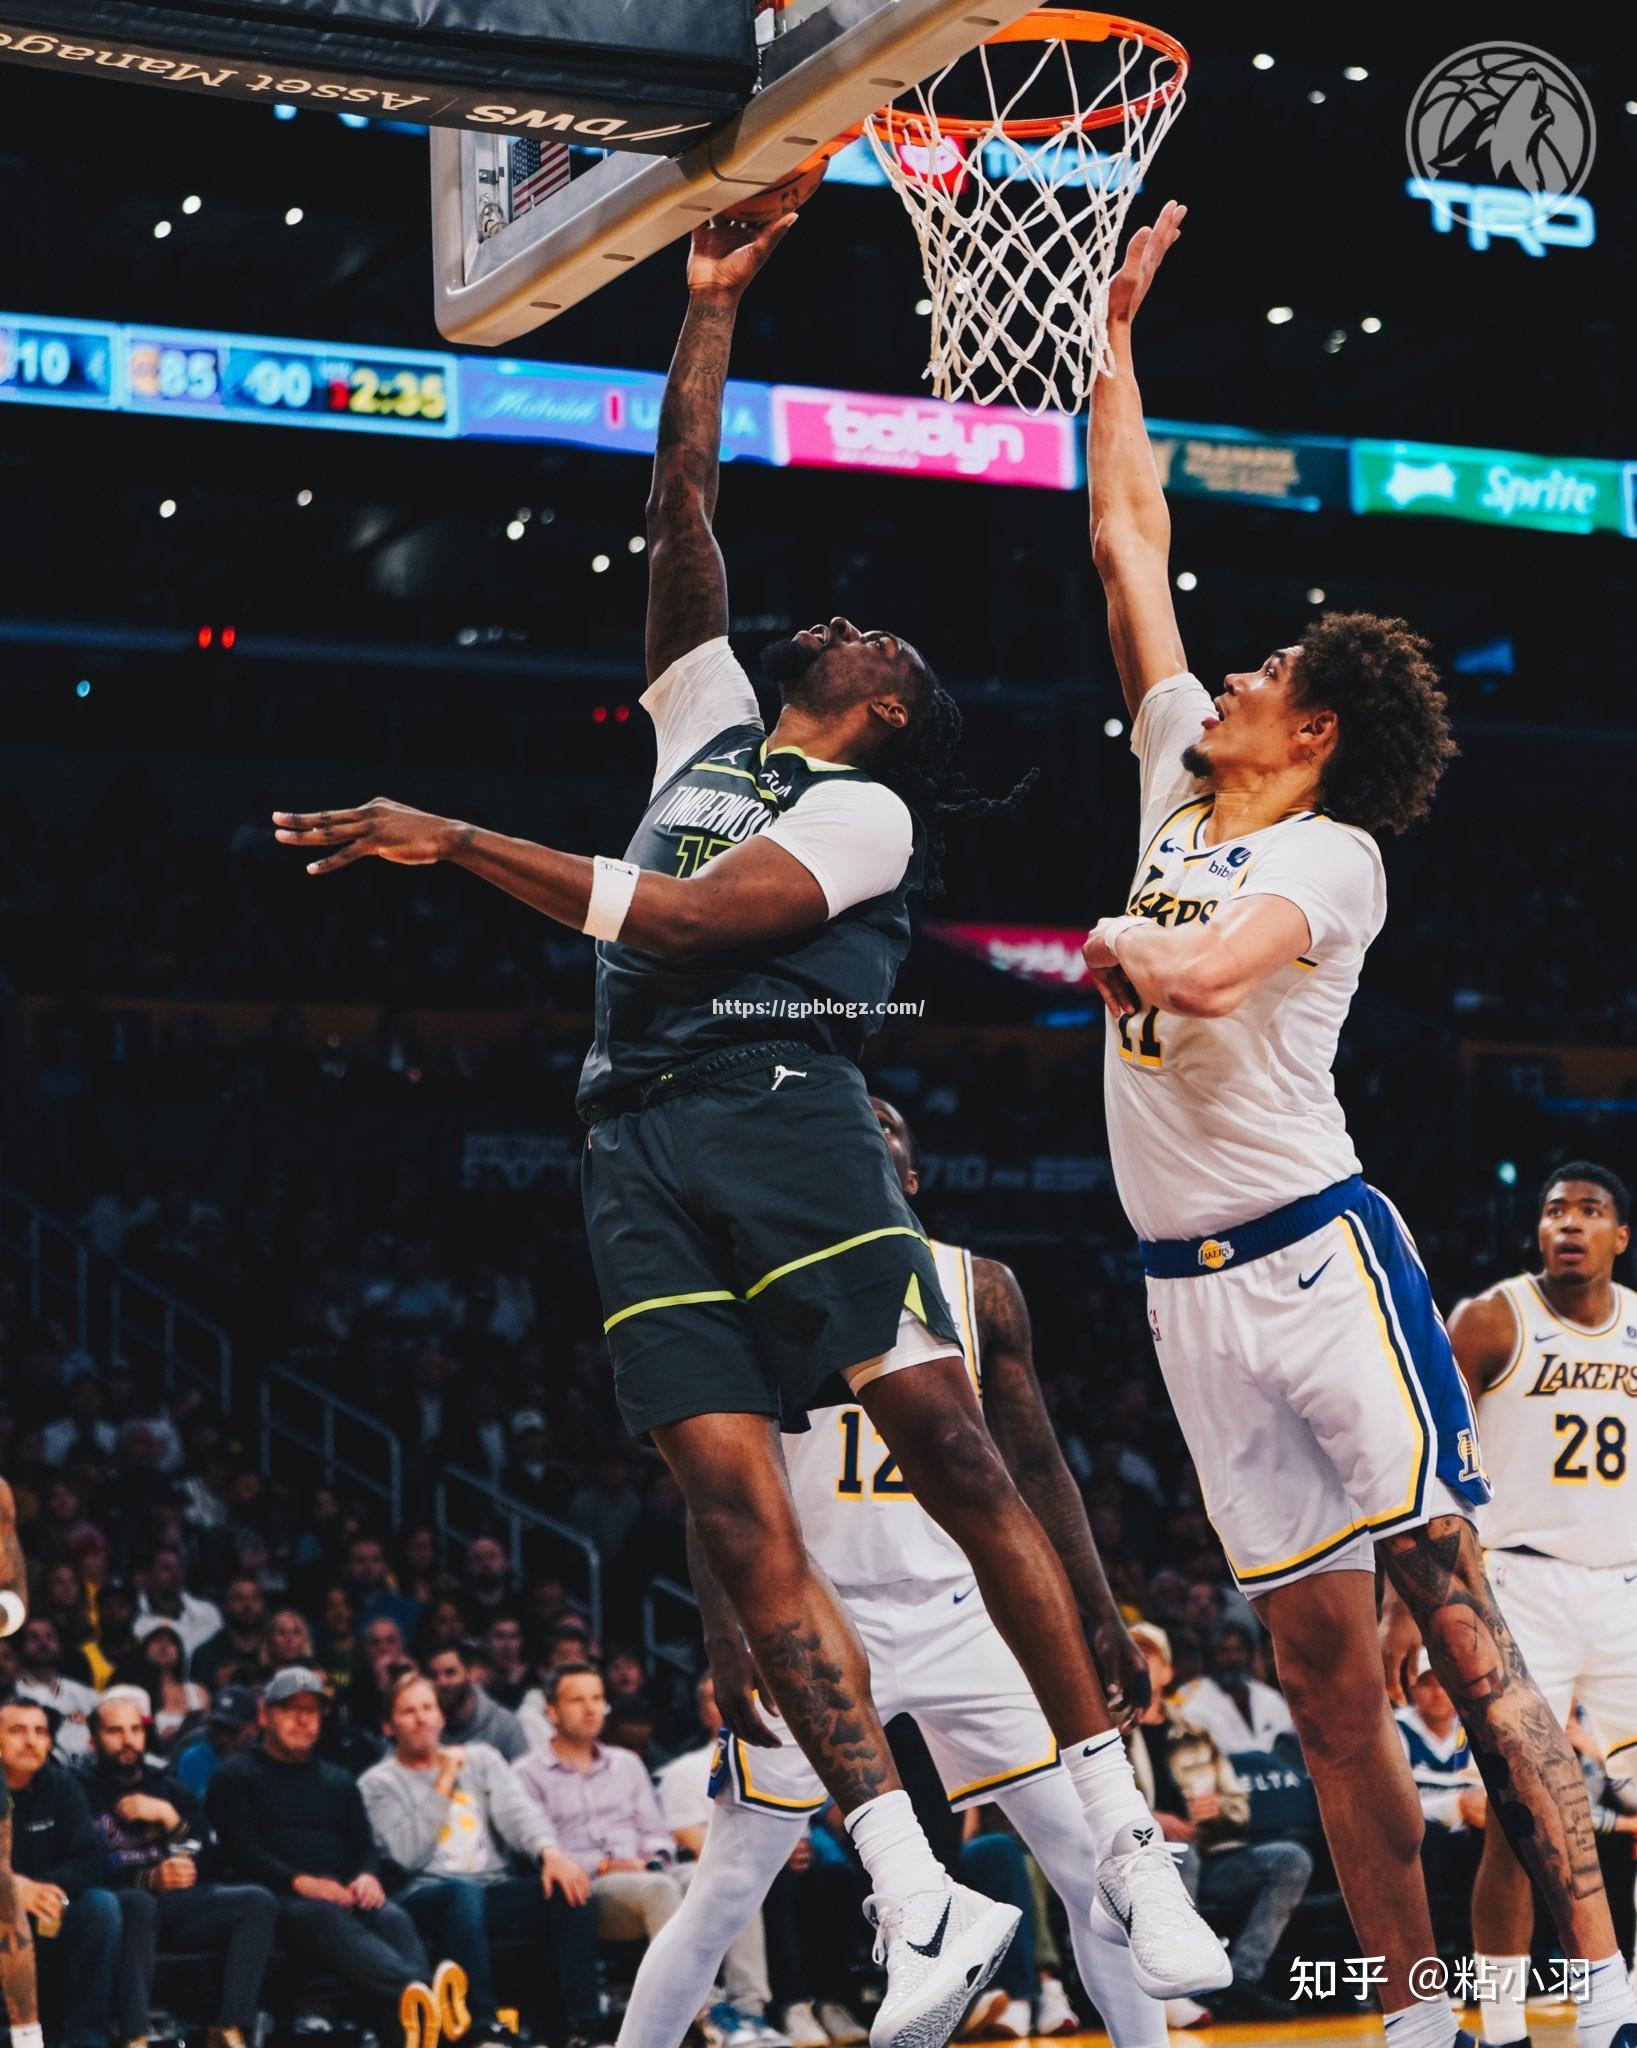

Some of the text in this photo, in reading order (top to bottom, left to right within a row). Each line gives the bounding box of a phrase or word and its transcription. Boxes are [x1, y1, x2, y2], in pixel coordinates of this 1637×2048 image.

[246, 74, 430, 111] Asset
[465, 104, 628, 137] DWS
[1405, 178, 1597, 257] TRD
[159, 348, 218, 400] 85
[350, 367, 447, 419] 2:35
[825, 401, 1025, 474] boldyn
[1482, 464, 1598, 519] Sprite
[1554, 1412, 1628, 1487] 28
